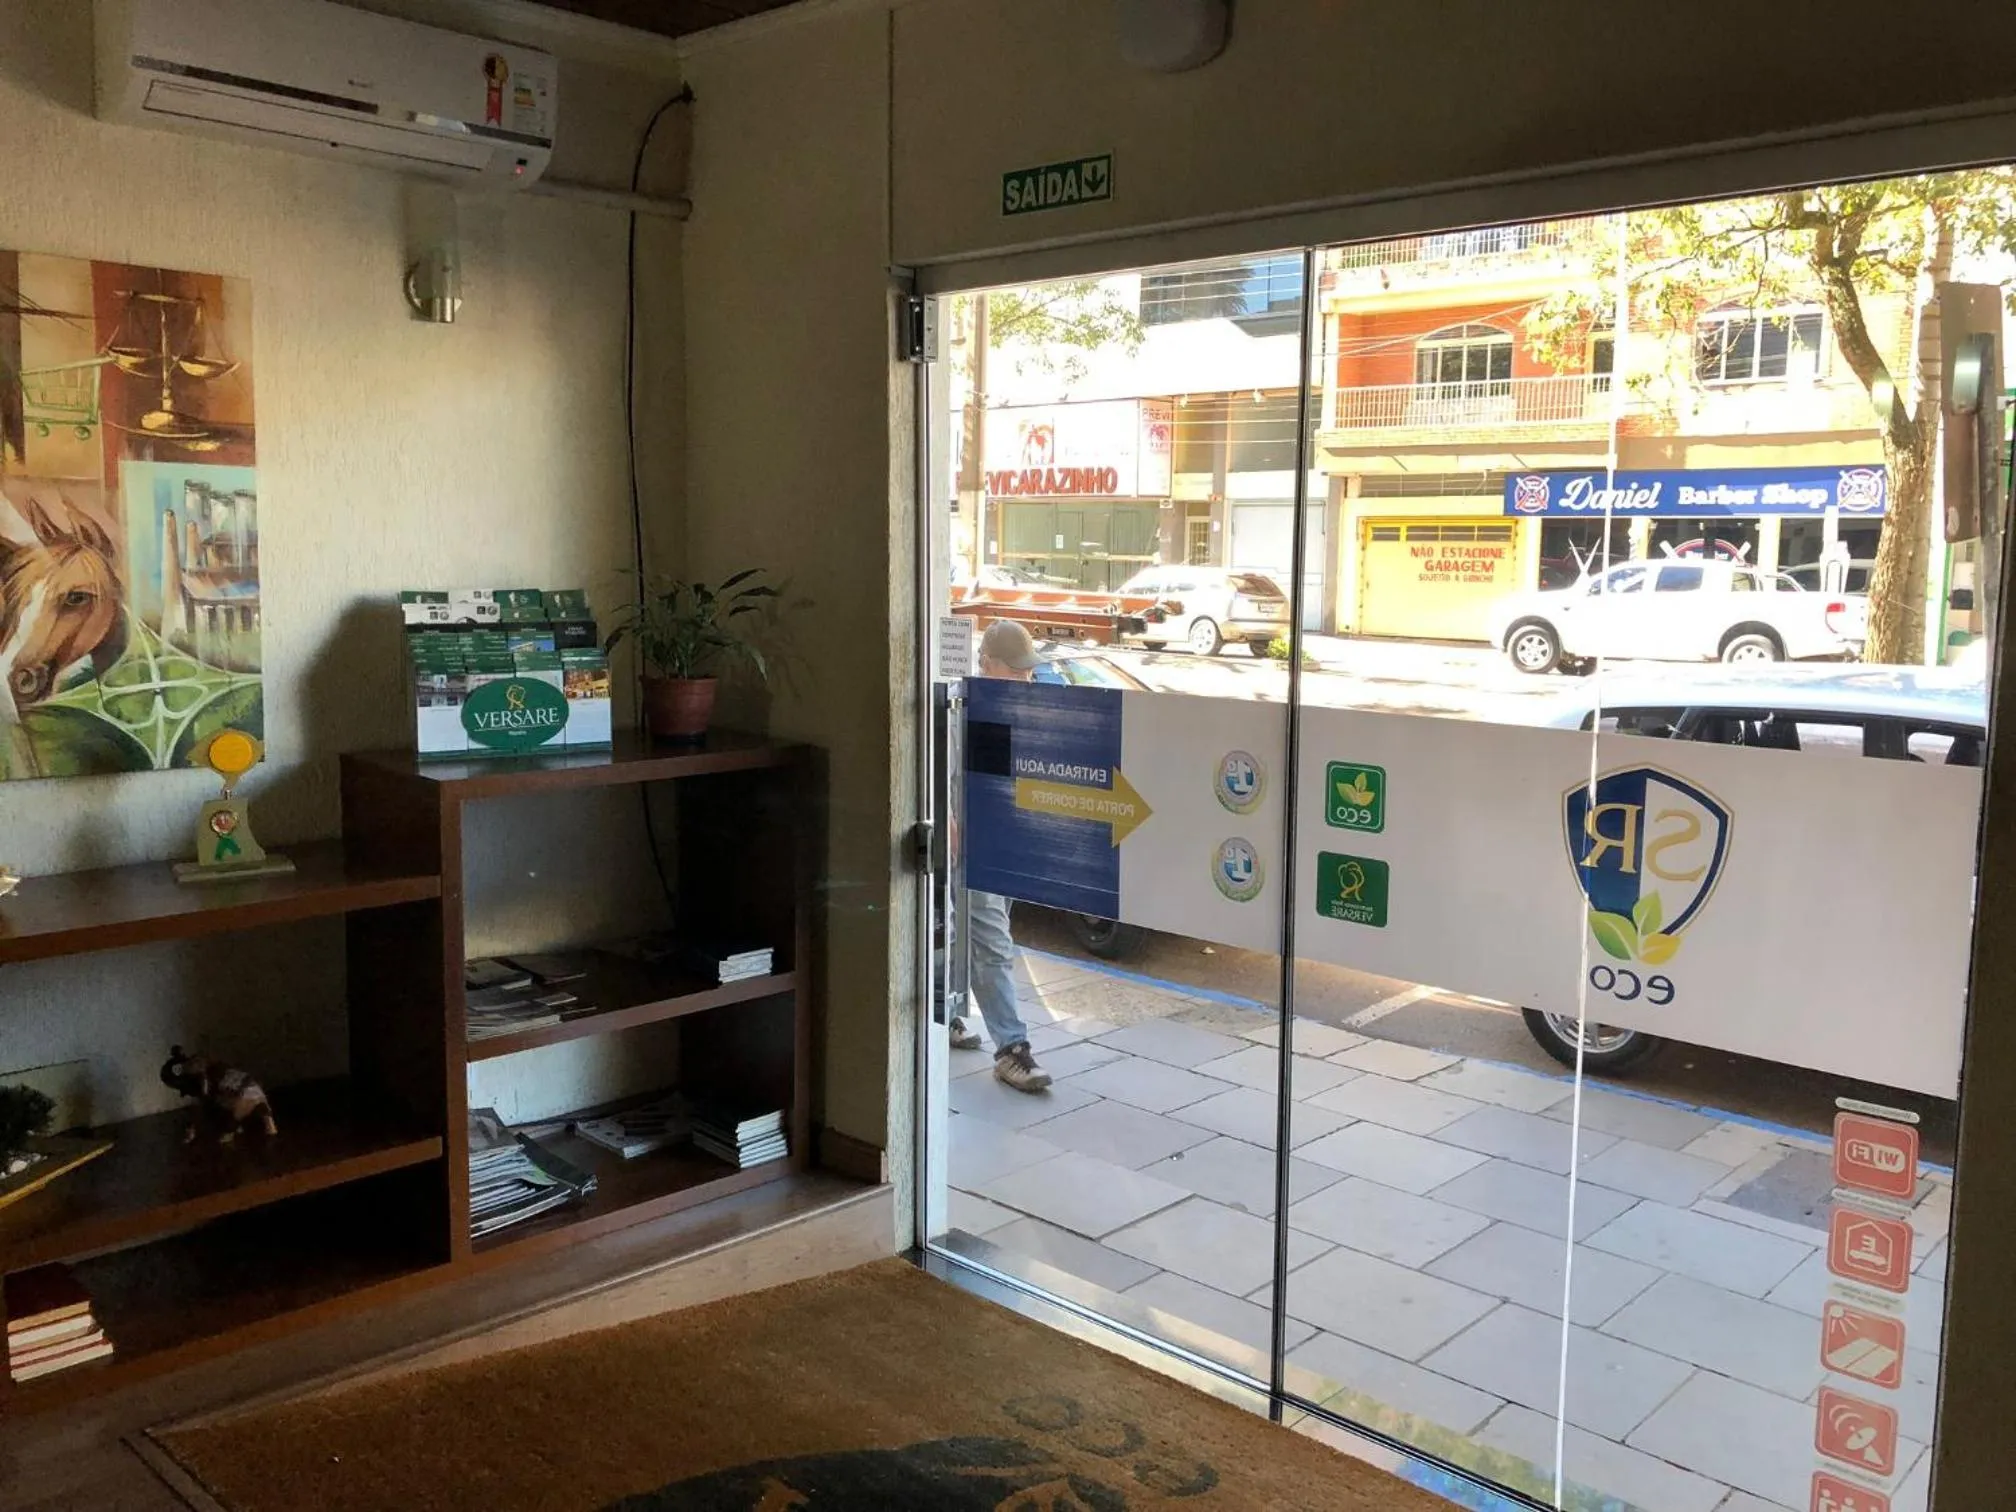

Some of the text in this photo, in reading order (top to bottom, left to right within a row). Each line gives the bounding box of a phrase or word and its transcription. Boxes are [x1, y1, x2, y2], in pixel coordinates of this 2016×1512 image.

[1006, 168, 1080, 210] SAÍDA
[1559, 476, 1829, 511] Daniel Barber Shop
[1410, 544, 1507, 559] NÃO ESTACIONE
[1424, 560, 1495, 573] GARAGEM
[474, 707, 560, 729] VERSARE
